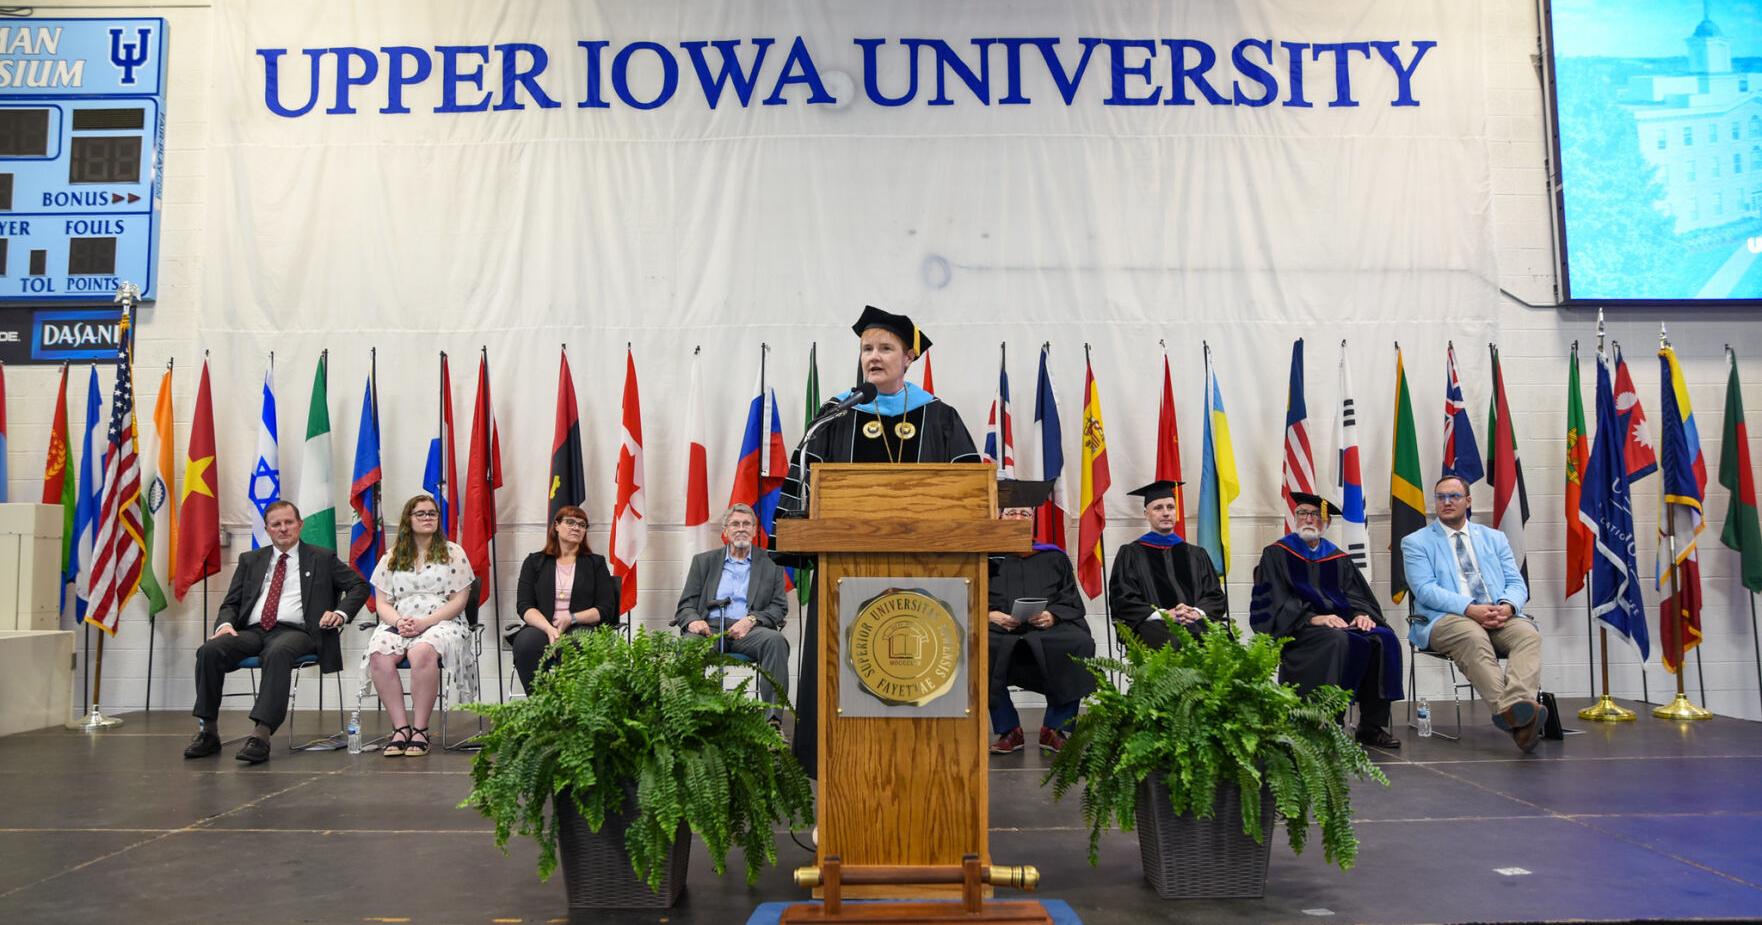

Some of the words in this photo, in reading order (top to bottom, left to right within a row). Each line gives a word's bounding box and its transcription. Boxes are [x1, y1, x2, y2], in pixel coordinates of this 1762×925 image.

[256, 42, 561, 118] UPPER
[577, 35, 837, 110] IOWA
[853, 37, 1437, 108] UNIVERSITY
[42, 191, 109, 207] BONUS
[65, 219, 125, 235] FOULS
[20, 277, 55, 293] TOL
[66, 277, 120, 291] POINTS
[43, 322, 119, 348] DASANI
[856, 622, 875, 679] SUPERIOR
[870, 597, 940, 621] UNIVERSIT
